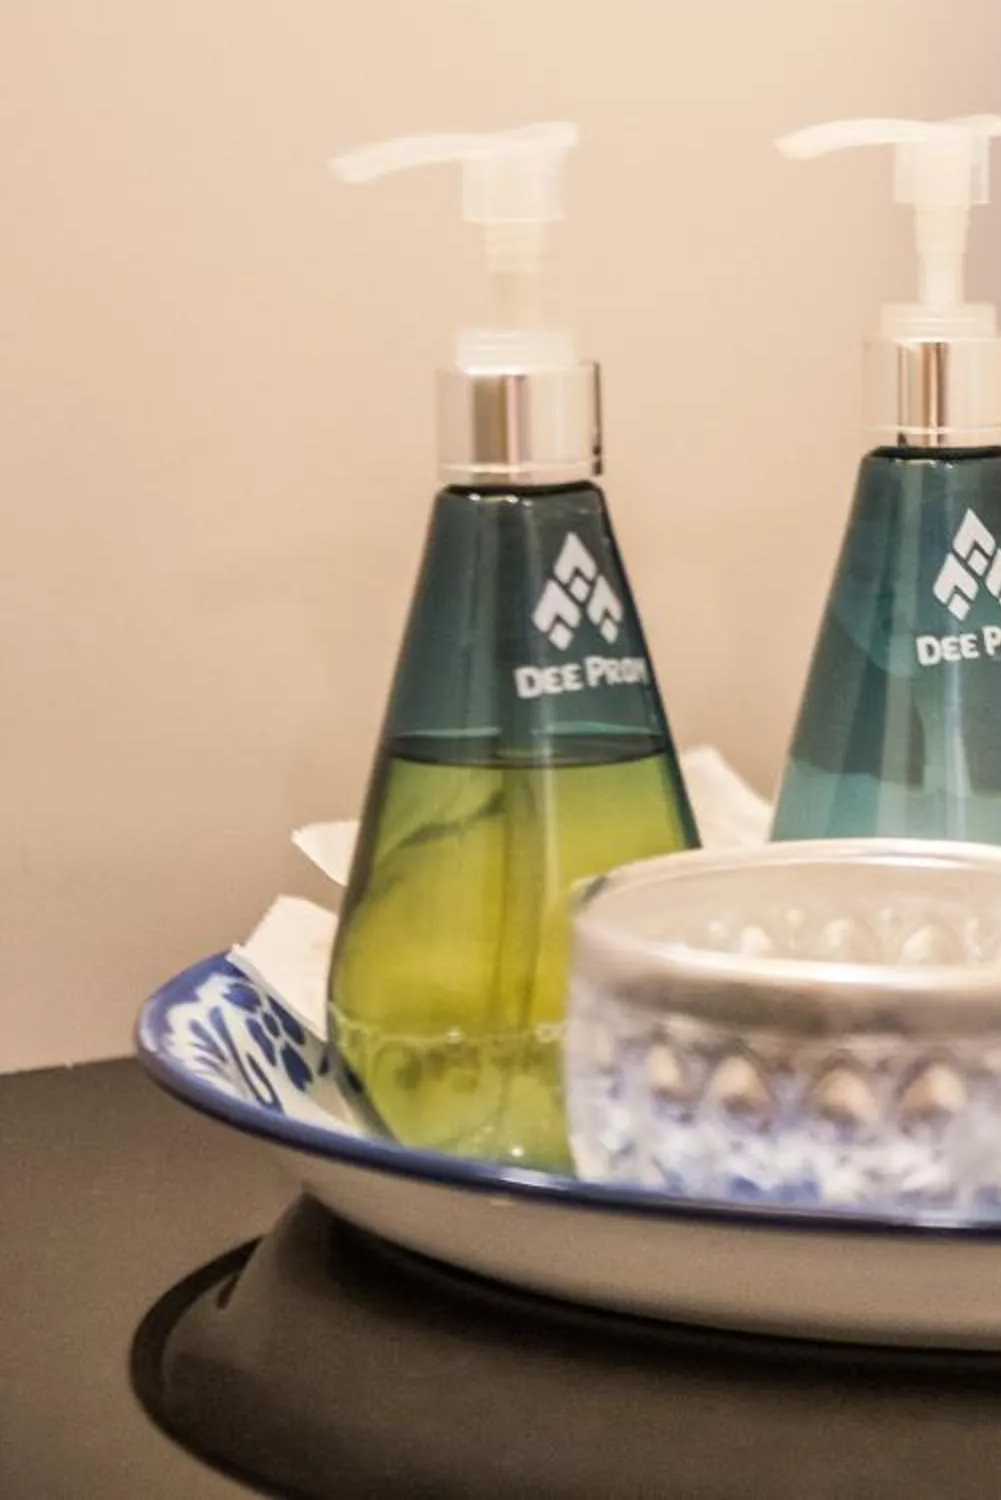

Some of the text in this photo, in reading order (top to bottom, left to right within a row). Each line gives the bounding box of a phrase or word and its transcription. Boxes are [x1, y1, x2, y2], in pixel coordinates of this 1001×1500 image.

[915, 635, 980, 667] DEE
[513, 655, 649, 699] DEE PROM
